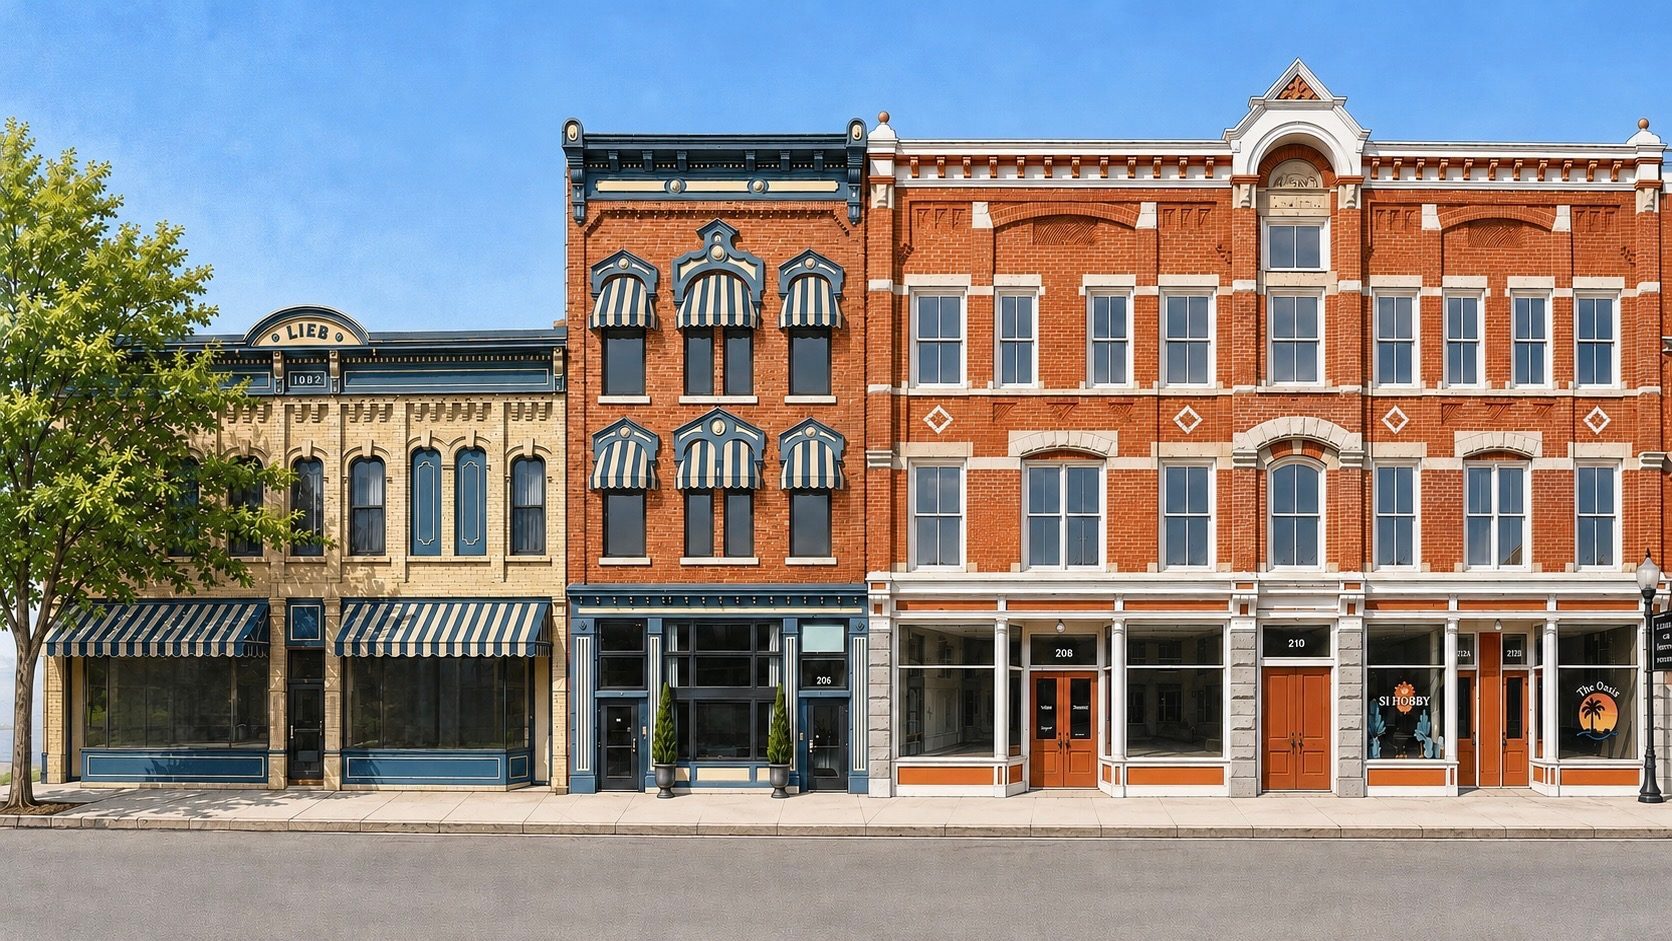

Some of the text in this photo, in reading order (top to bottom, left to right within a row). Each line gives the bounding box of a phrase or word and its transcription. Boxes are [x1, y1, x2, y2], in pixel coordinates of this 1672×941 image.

[286, 323, 329, 340] LIEB
[1288, 638, 1305, 648] 210
[1055, 648, 1073, 658] 208
[816, 676, 831, 685] 206
[1576, 681, 1620, 698] The Oasis
[1392, 696, 1431, 706] HOBBY
